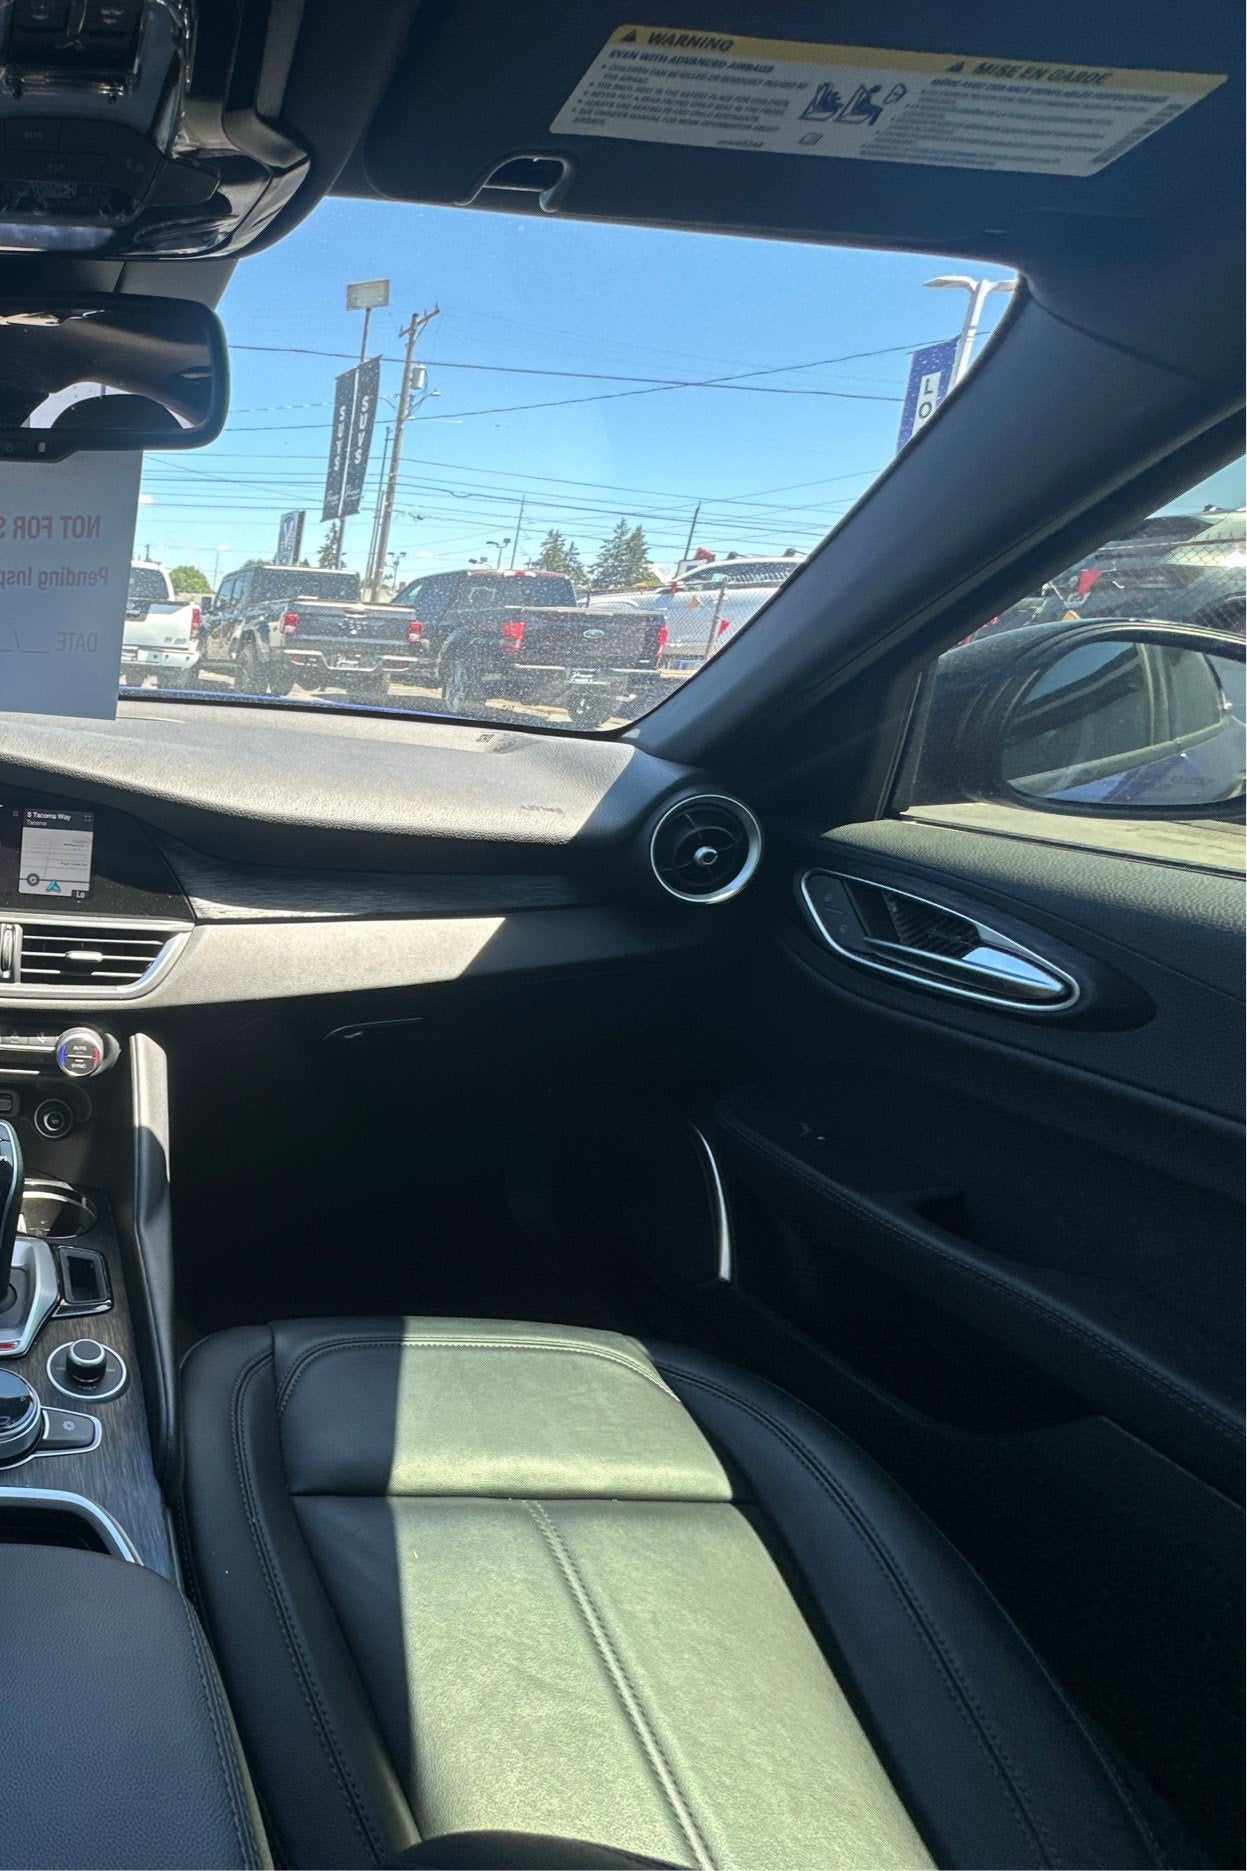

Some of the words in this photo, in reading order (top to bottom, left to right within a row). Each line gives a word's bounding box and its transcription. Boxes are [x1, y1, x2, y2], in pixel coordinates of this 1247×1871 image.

[647, 31, 734, 52] WARNING
[918, 378, 933, 419] LO
[58, 813, 72, 822] Way
[76, 891, 86, 899] Lo
